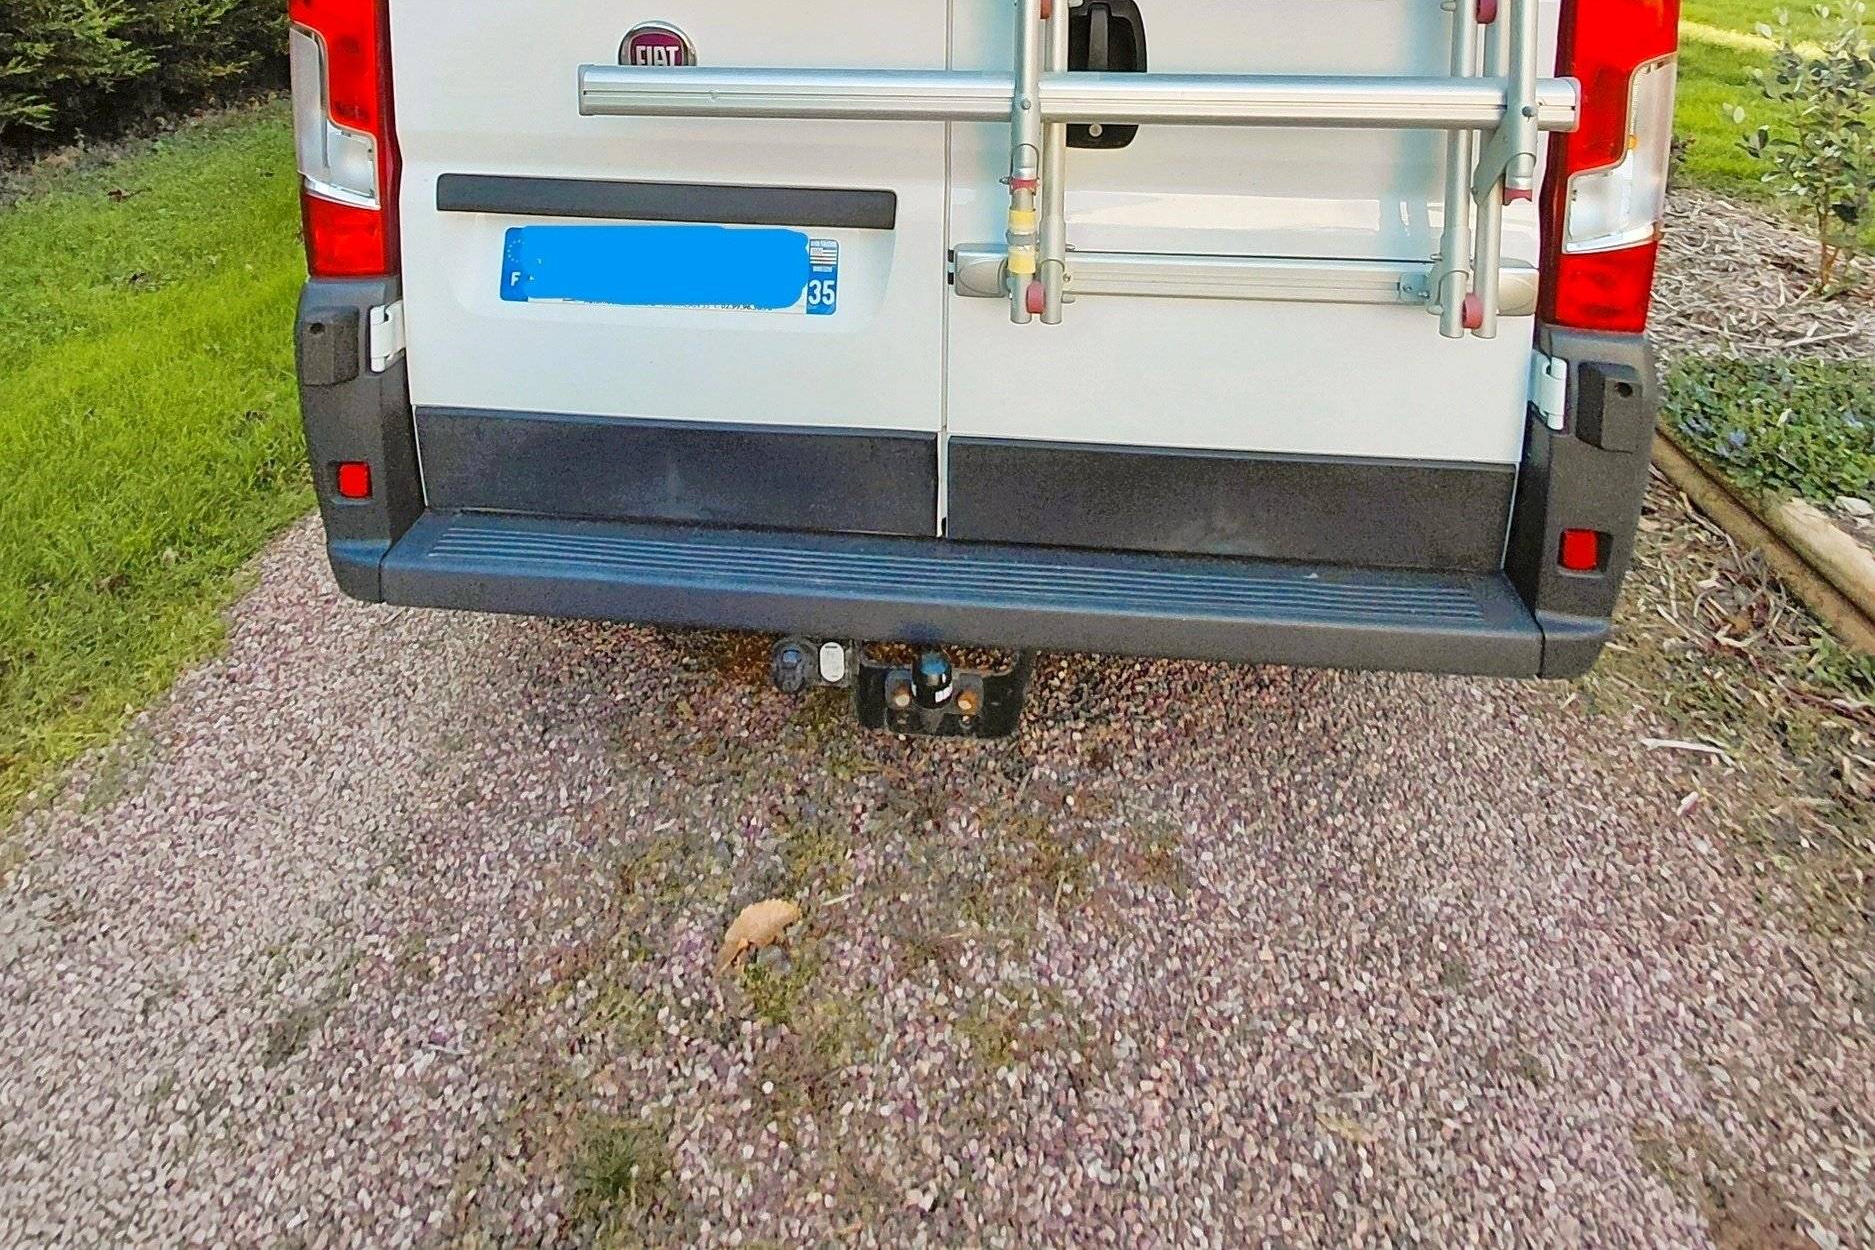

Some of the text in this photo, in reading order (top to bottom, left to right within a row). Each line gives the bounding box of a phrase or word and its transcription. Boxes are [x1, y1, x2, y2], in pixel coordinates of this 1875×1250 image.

[636, 46, 679, 66] FIAT
[510, 271, 521, 286] F
[808, 279, 835, 305] 35
